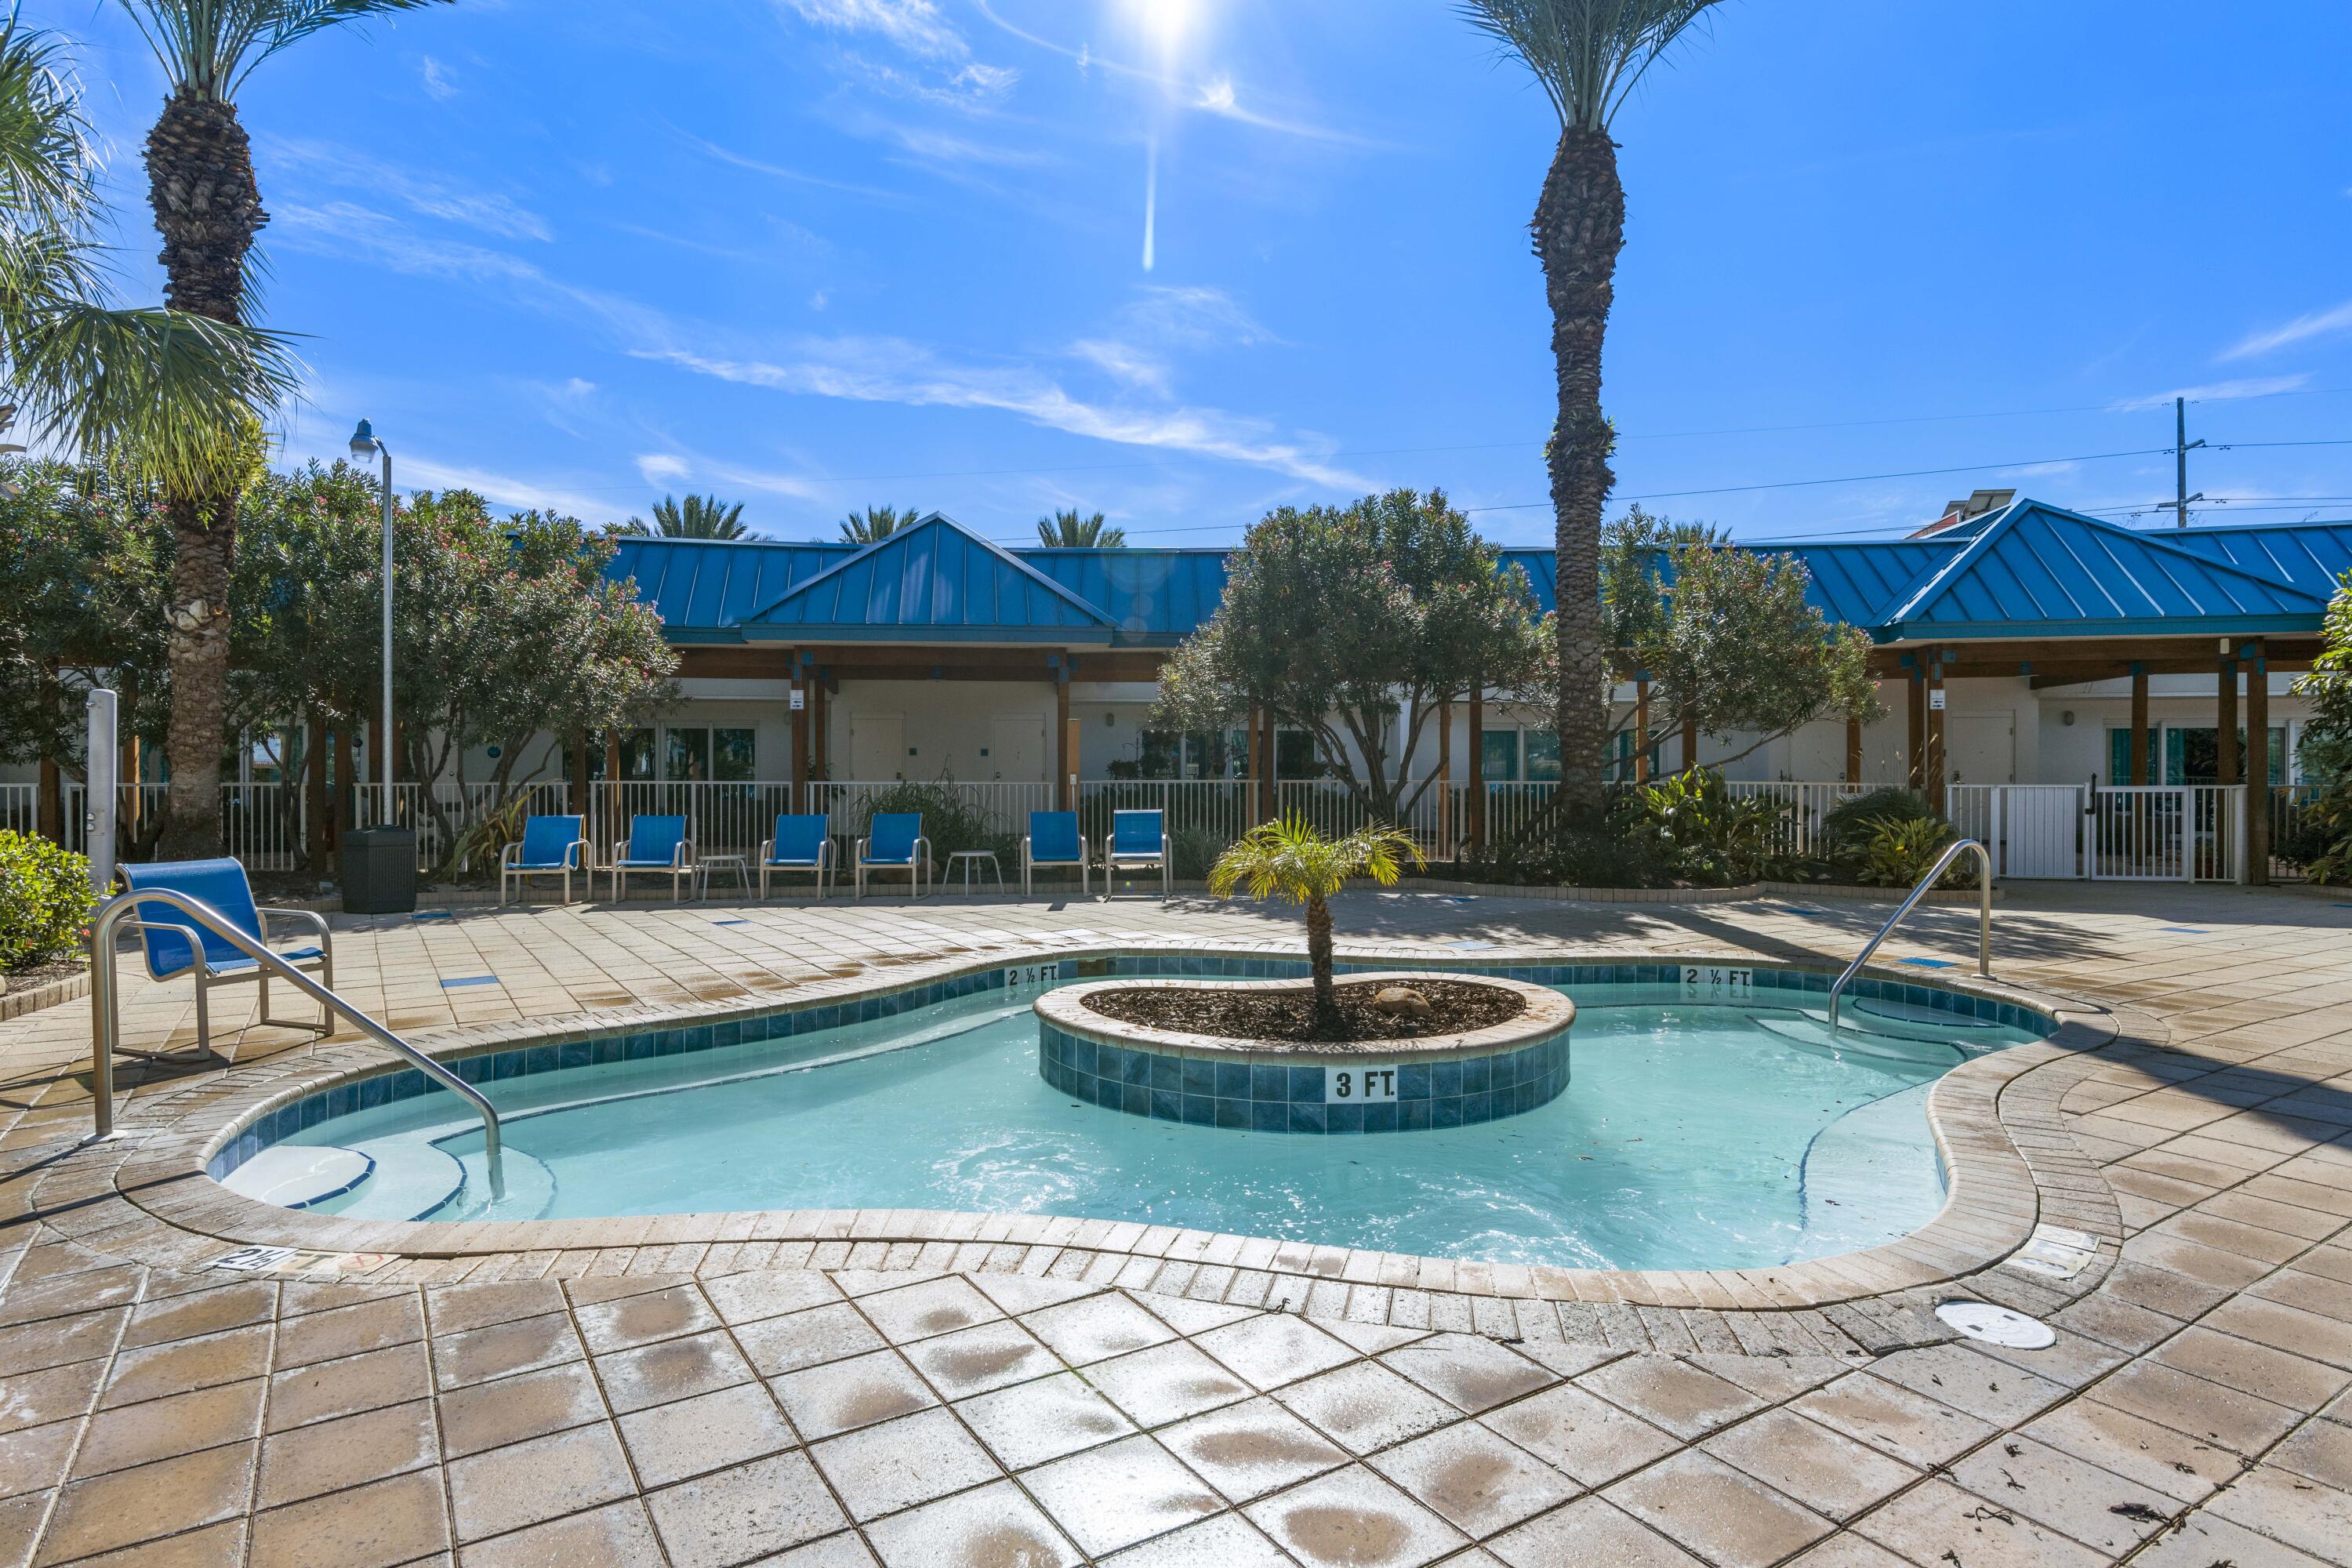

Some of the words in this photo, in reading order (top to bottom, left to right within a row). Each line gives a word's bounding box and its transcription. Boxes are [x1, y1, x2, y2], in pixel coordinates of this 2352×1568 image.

[1010, 970, 1018, 985] 2
[1687, 968, 1697, 983] 2
[1337, 1073, 1351, 1098] 3
[1365, 1071, 1395, 1097] FT.
